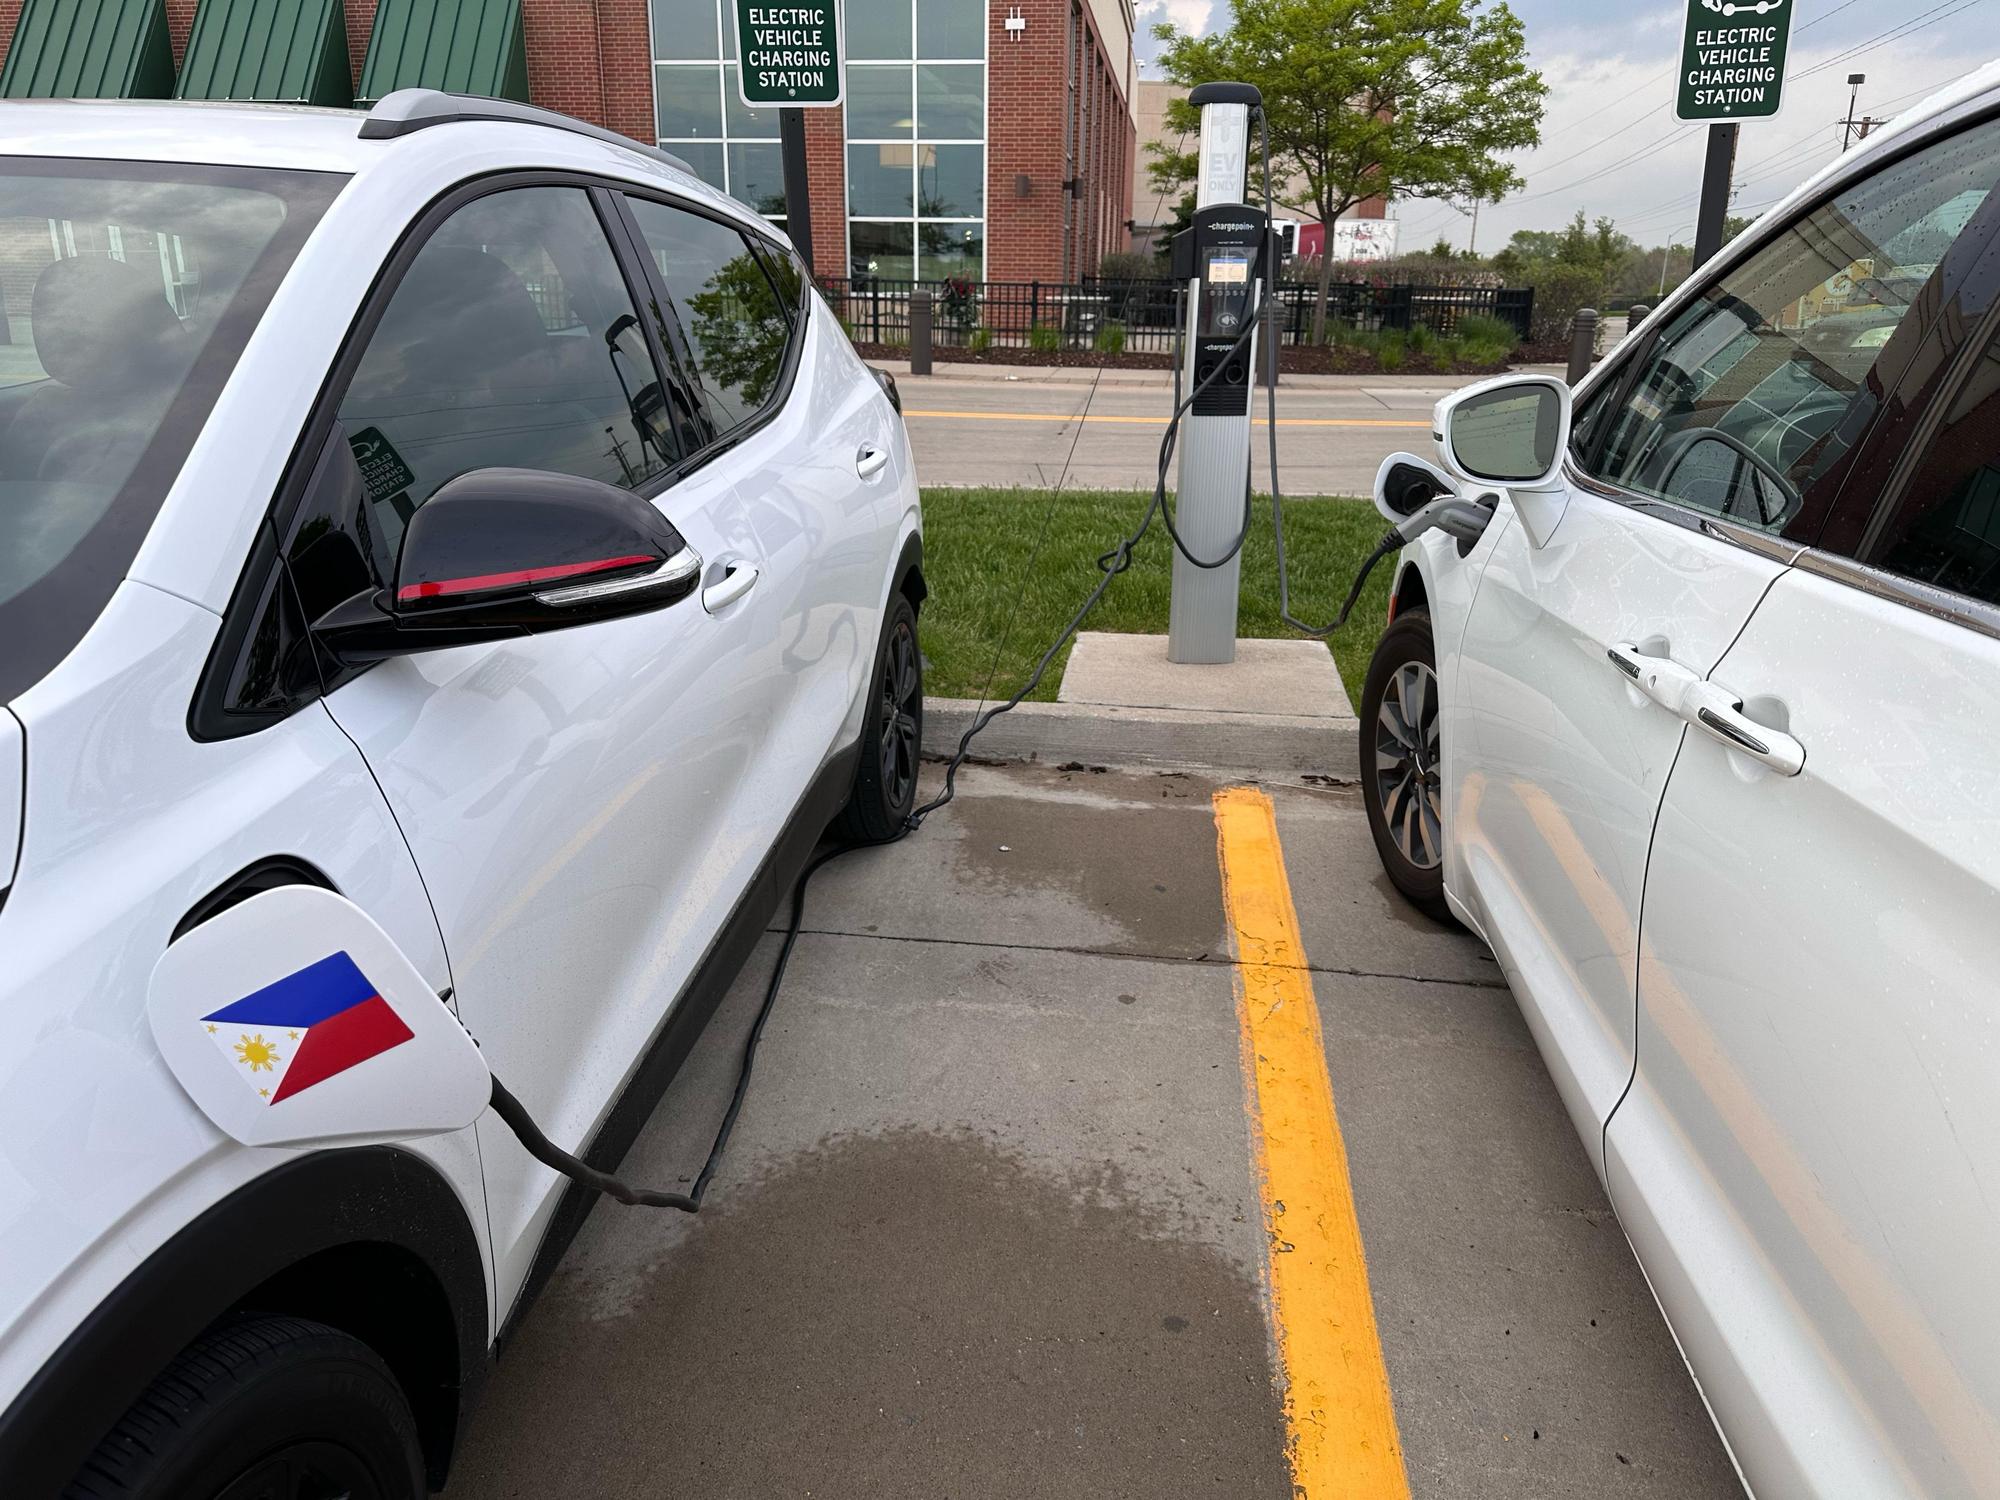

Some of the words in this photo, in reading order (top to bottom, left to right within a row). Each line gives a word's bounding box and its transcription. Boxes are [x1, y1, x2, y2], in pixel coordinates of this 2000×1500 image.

[749, 8, 824, 25] ELECTRIC
[754, 30, 823, 46] VEHICLE
[1696, 27, 1776, 46] ELECTRIC
[748, 50, 831, 67] CHARGING
[1699, 47, 1771, 65] VEHICLE
[759, 71, 824, 87] STATION
[1688, 66, 1775, 86] CHARGING
[1694, 87, 1765, 105] STATION
[1209, 153, 1238, 172] EV
[1209, 180, 1236, 191] ONLY
